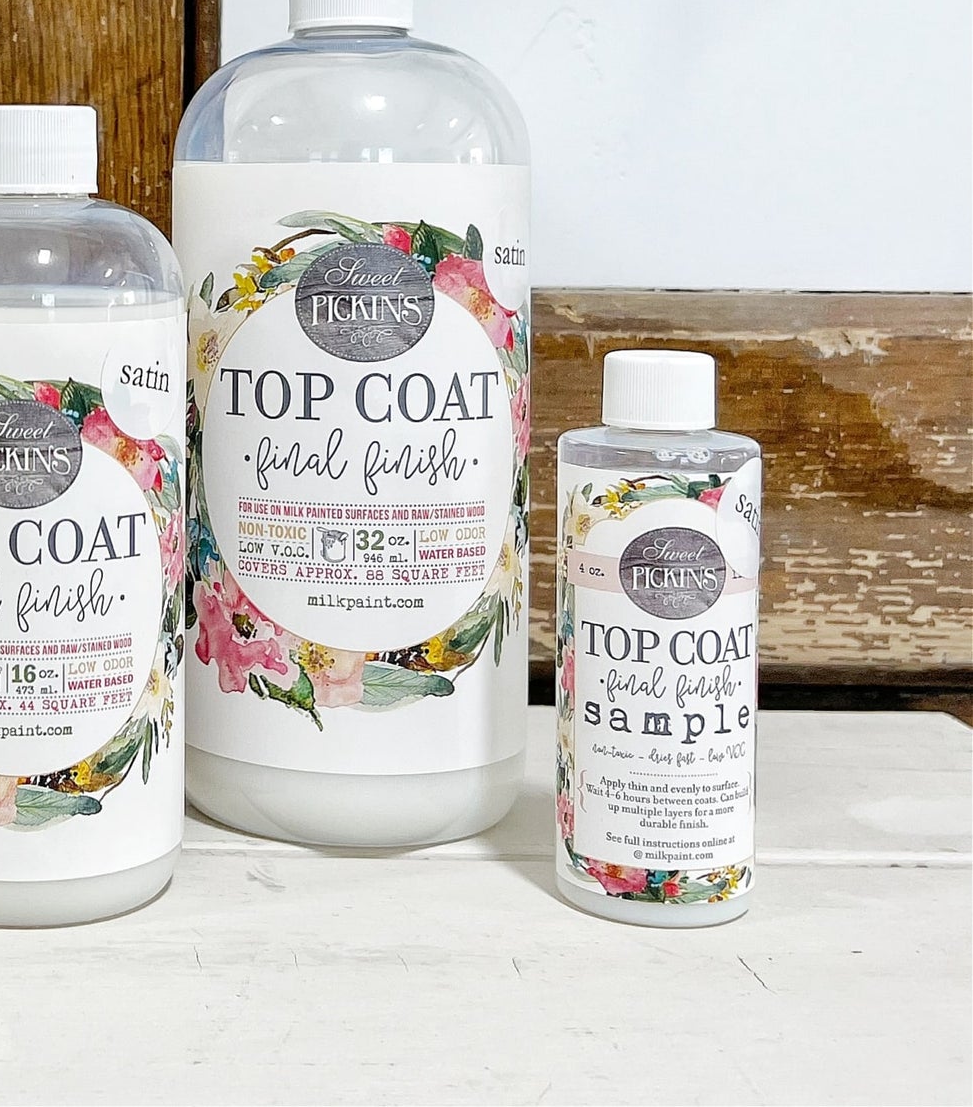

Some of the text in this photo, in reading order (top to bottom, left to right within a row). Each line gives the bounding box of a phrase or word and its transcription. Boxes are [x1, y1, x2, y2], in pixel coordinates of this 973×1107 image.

[495, 239, 525, 266] satin
[325, 257, 405, 286] Sweet
[311, 293, 422, 326] PICKINS
[120, 360, 170, 393] satin
[220, 368, 498, 423] TOP COAT
[256, 428, 466, 495] final finish
[239, 502, 485, 520] FOR USE ON MILK PAINTED SURFACES AND RAW/STAINED WOOD
[9, 512, 146, 565] COAT
[238, 522, 307, 540] NON-TOXIC
[356, 529, 410, 551] 32 oz.
[419, 526, 486, 543] LOW ODOR
[238, 541, 309, 559] LOW V.O.C.
[363, 553, 408, 563] 946 ml.
[419, 546, 486, 560] WATER BASED
[642, 538, 706, 561] Sweet
[238, 560, 485, 582] COVERS APPROX. 88 SQUARE FEET
[578, 562, 605, 576] 4 oz.
[632, 566, 717, 591] PICKINS
[17, 568, 113, 633] finish
[307, 594, 424, 610] milkpaint.com
[0, 645, 40, 655] SURFACES
[42, 645, 59, 655] AND
[60, 640, 112, 653] RAW/STAINED
[113, 637, 132, 648] WOOD
[581, 620, 753, 665] TOP COAT
[11, 664, 59, 683] 16 oz.
[68, 656, 134, 675] LOW ODOR
[16, 685, 57, 695] 473 ml.
[68, 674, 134, 691] WATER BASED
[607, 664, 736, 708] final finish
[20, 701, 35, 710] 44
[42, 697, 96, 712] SQUARE
[103, 692, 132, 705] FEET
[584, 701, 750, 744] sample
[648, 748, 673, 765] dries
[677, 752, 695, 767] fast
[708, 748, 725, 763] low
[726, 741, 745, 759] VOC
[586, 783, 603, 796] Wait
[623, 791, 650, 804] hours
[653, 795, 692, 805] between
[695, 795, 718, 805] coats.
[720, 792, 734, 802] Can
[735, 786, 749, 800] build
[600, 776, 739, 794] Apply thin and evenly to surface.
[608, 803, 619, 814] up
[622, 804, 662, 818] multiple
[665, 807, 692, 820] layers
[695, 807, 708, 817] for
[715, 805, 734, 815] more
[640, 818, 708, 829] durable finish.
[606, 832, 735, 849] See full instructions online at
[634, 850, 713, 863] @ milkpaint.com
